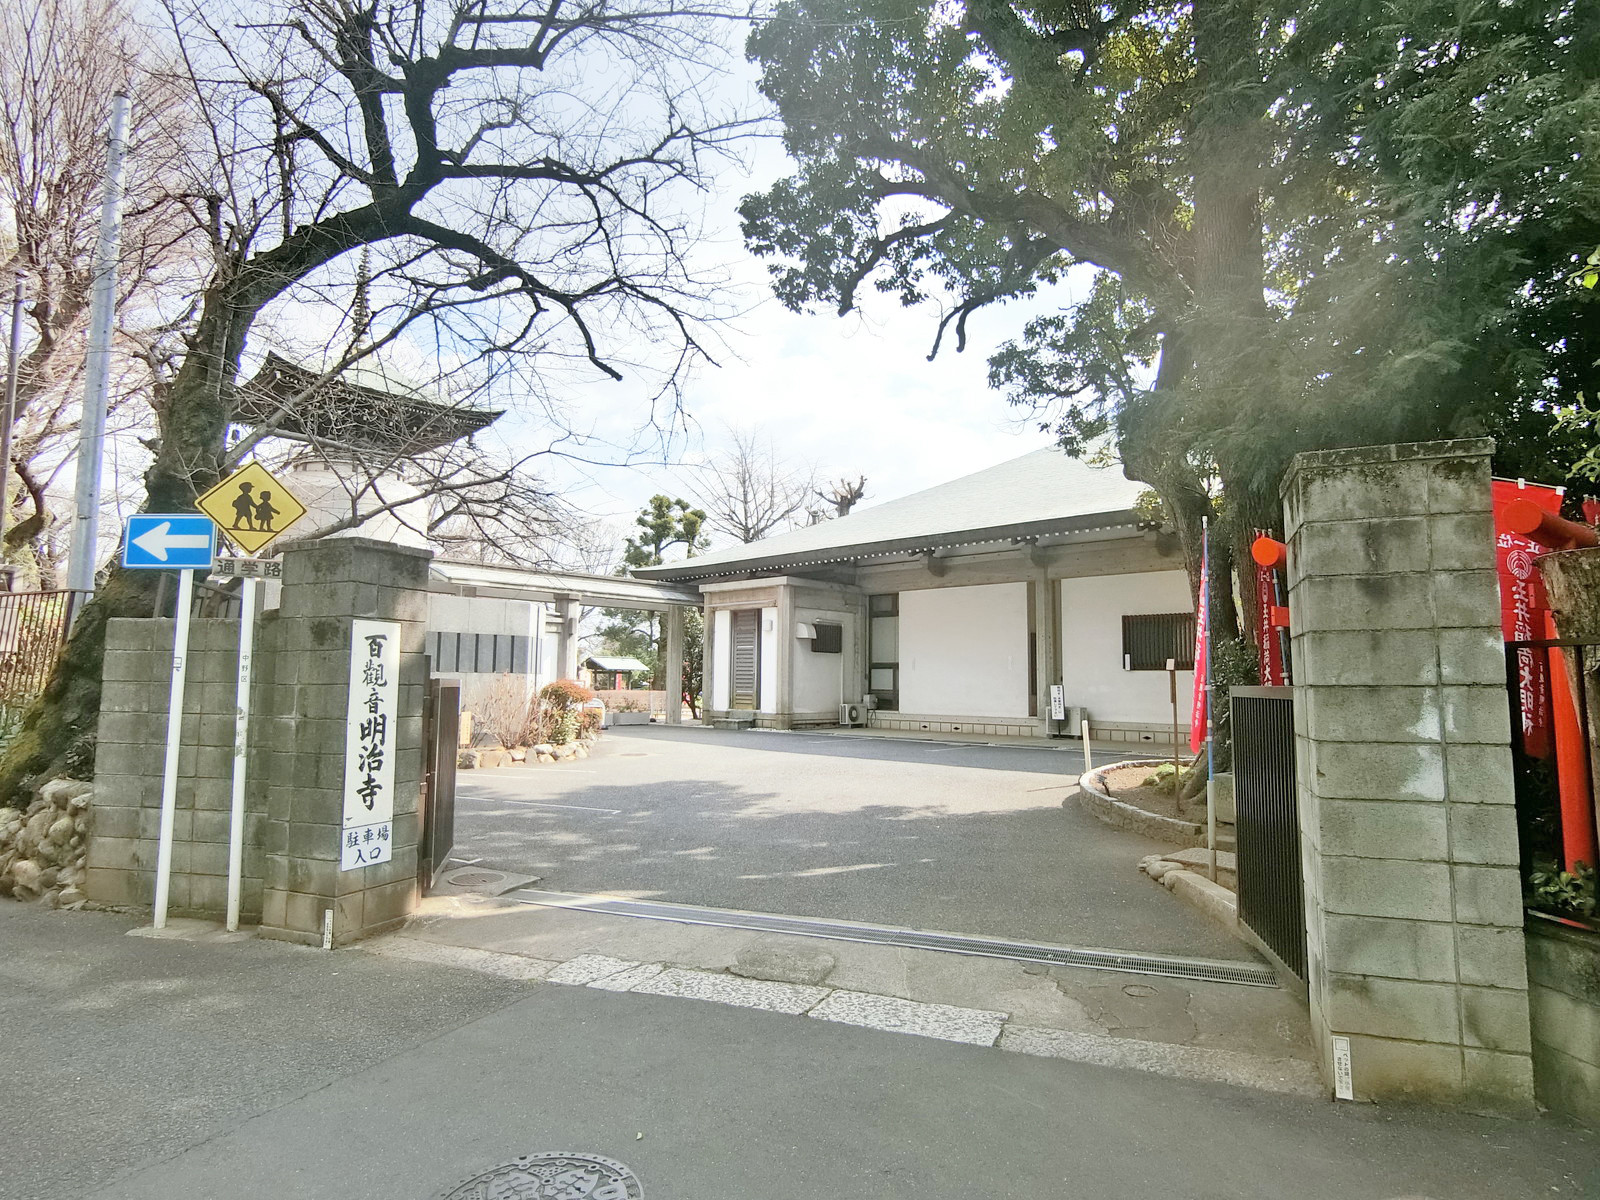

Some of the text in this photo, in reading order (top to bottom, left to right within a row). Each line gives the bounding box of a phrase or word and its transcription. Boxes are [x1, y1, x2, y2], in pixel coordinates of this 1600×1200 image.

[217, 559, 282, 578] 通学路
[241, 654, 249, 682] 中野区
[356, 634, 388, 811] 百觀音明治寺
[346, 825, 389, 847] 駐車場
[354, 847, 381, 865] 入口
